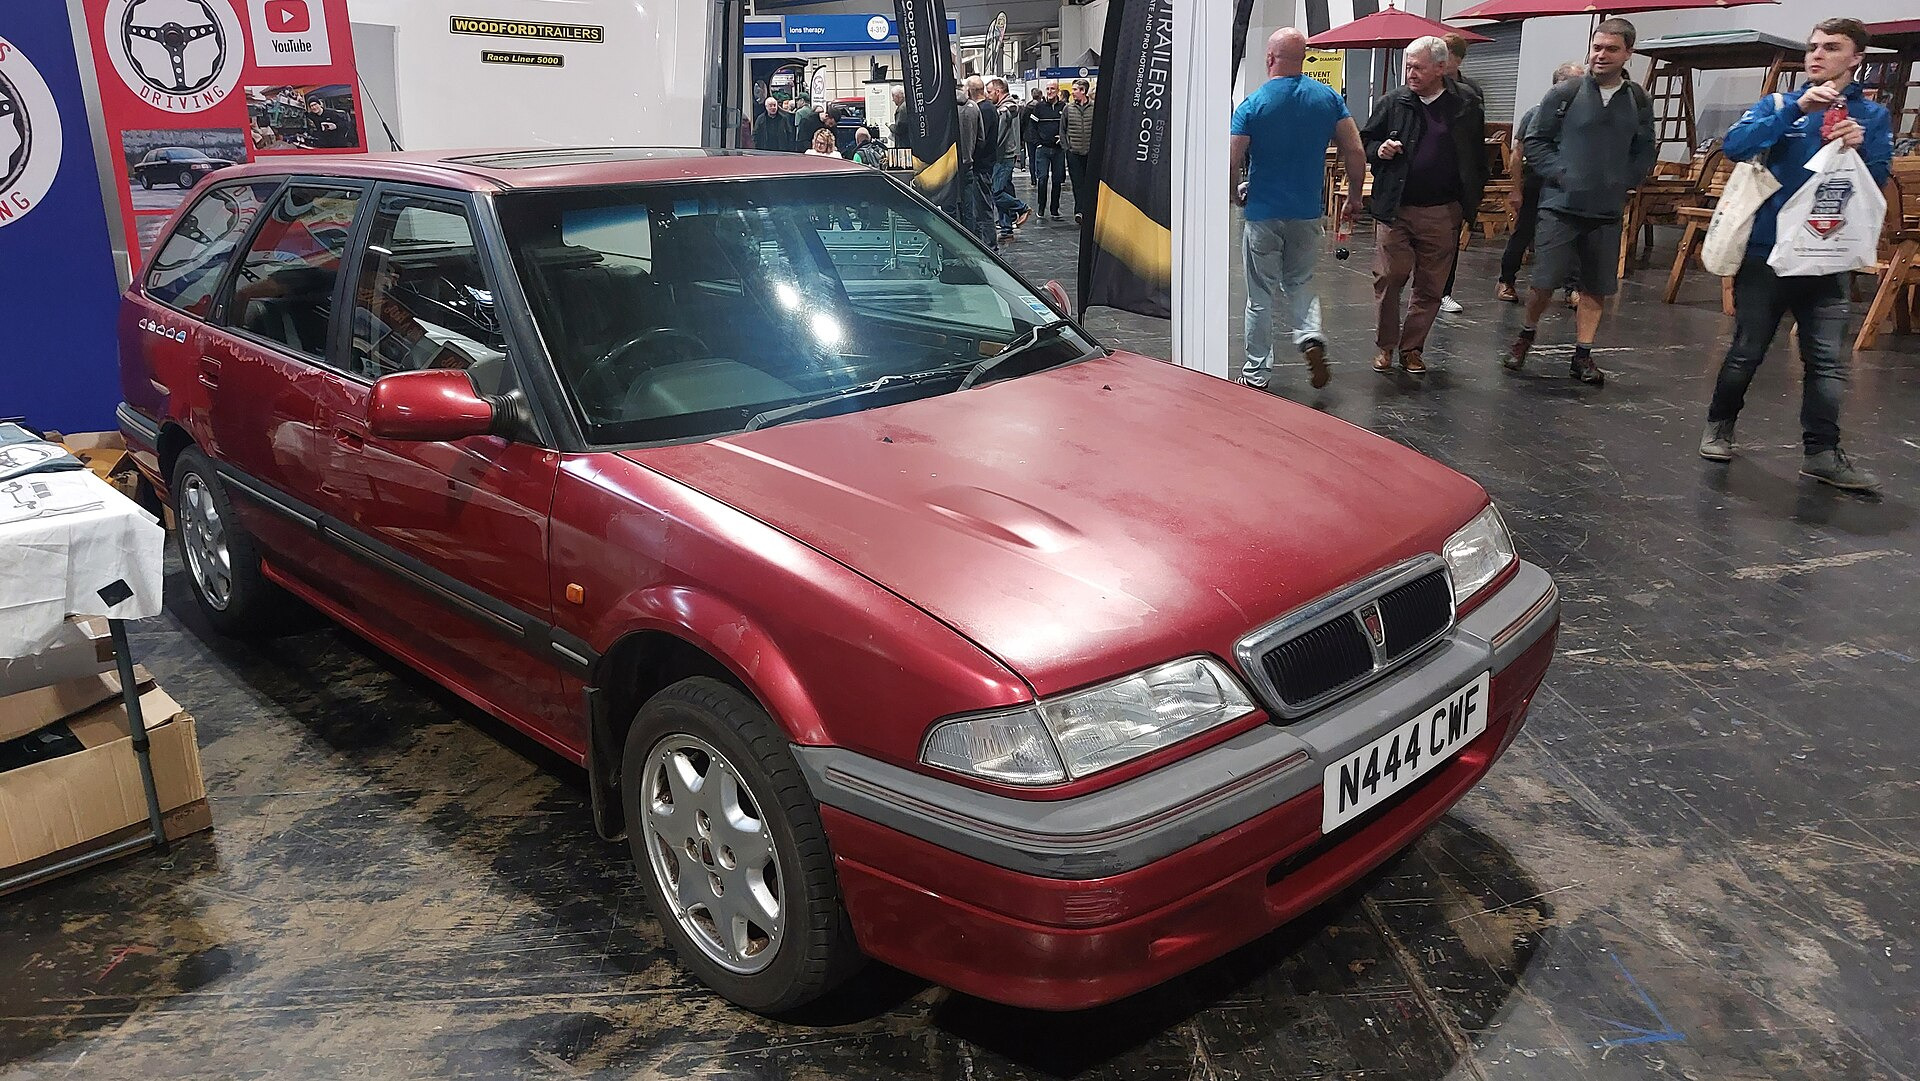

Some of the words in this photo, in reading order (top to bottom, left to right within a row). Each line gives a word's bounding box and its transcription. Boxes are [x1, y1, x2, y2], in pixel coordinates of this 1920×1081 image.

[455, 19, 599, 40] WOODFORDTRAILERS
[803, 26, 825, 35] therapy
[869, 26, 887, 34] 4-310
[1145, 13, 1154, 32] AND
[271, 38, 312, 53] YouTube
[1142, 33, 1151, 50] PRO
[487, 53, 510, 63] Race
[512, 54, 535, 64] Liner
[537, 56, 559, 65] 5000
[1132, 50, 1148, 107] MOTORSPORTS
[140, 85, 225, 110] DRIVING
[1151, 143, 1161, 165] 1989
[1338, 722, 1422, 814] N444
[1429, 684, 1480, 757] CWF
